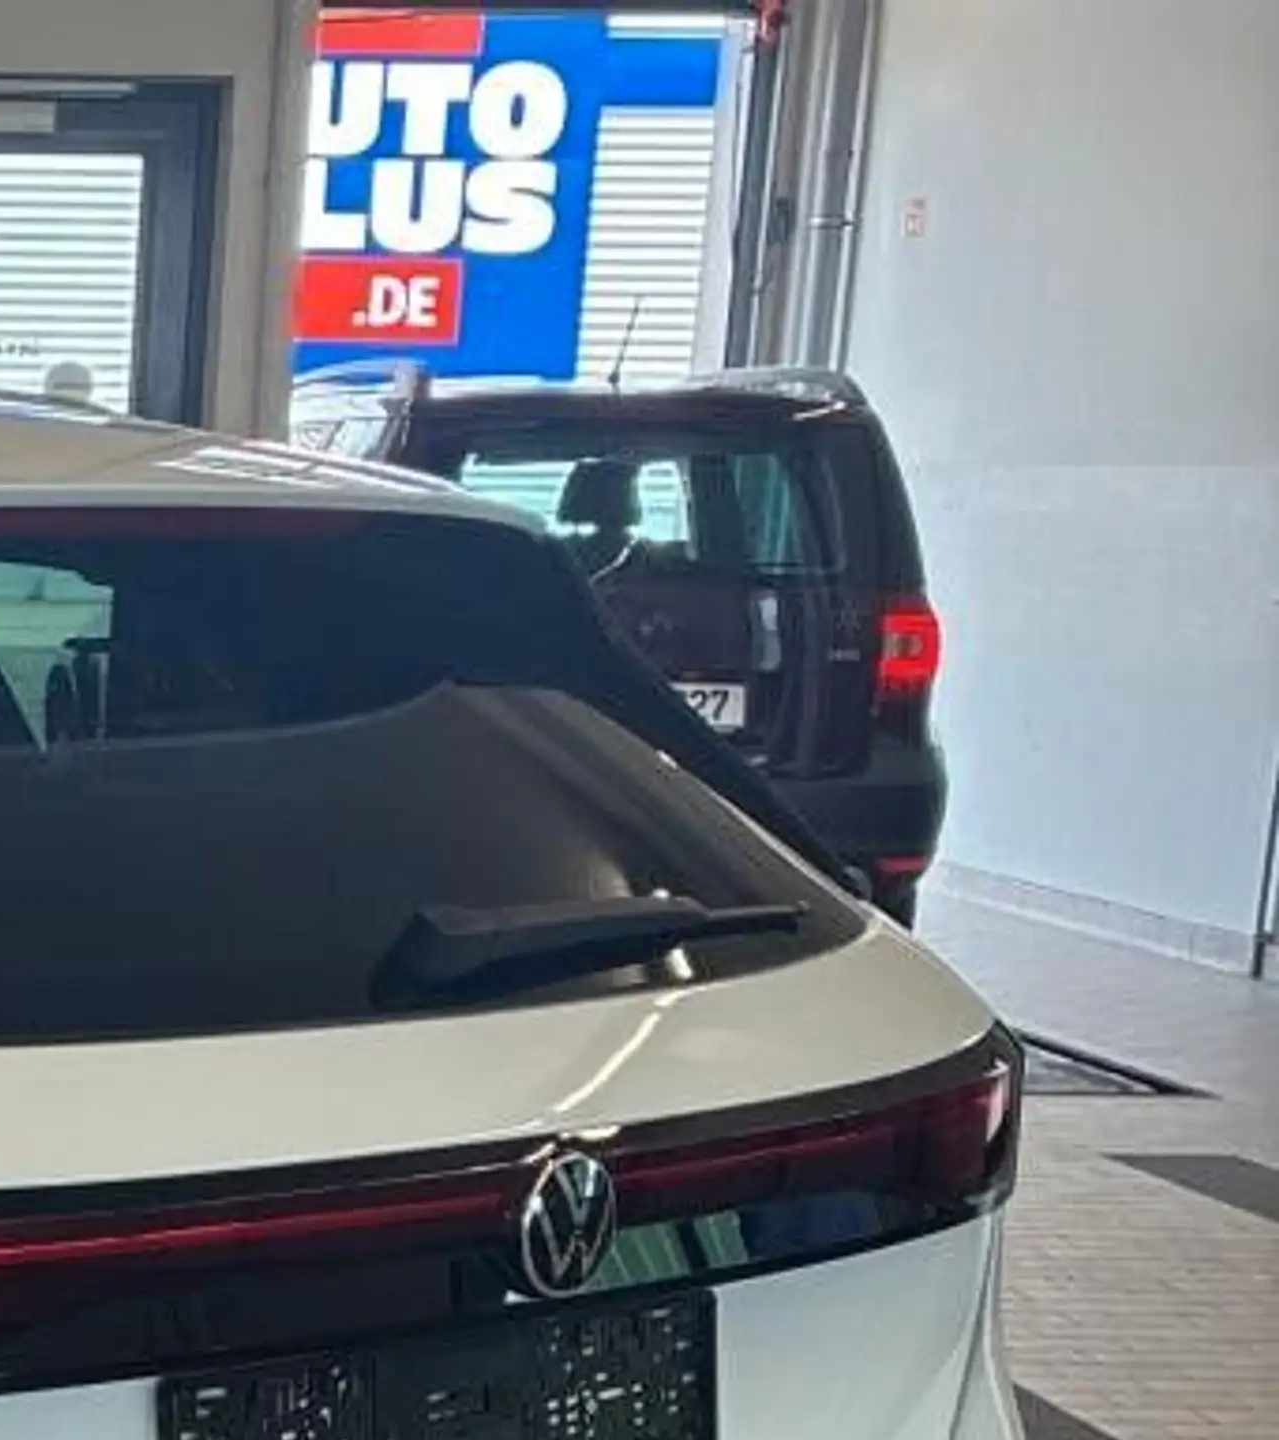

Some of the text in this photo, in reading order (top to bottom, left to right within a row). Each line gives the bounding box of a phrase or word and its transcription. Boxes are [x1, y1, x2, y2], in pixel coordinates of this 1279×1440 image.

[307, 60, 567, 157] UTO
[300, 158, 558, 255] LUS
[351, 274, 441, 327] .DE
